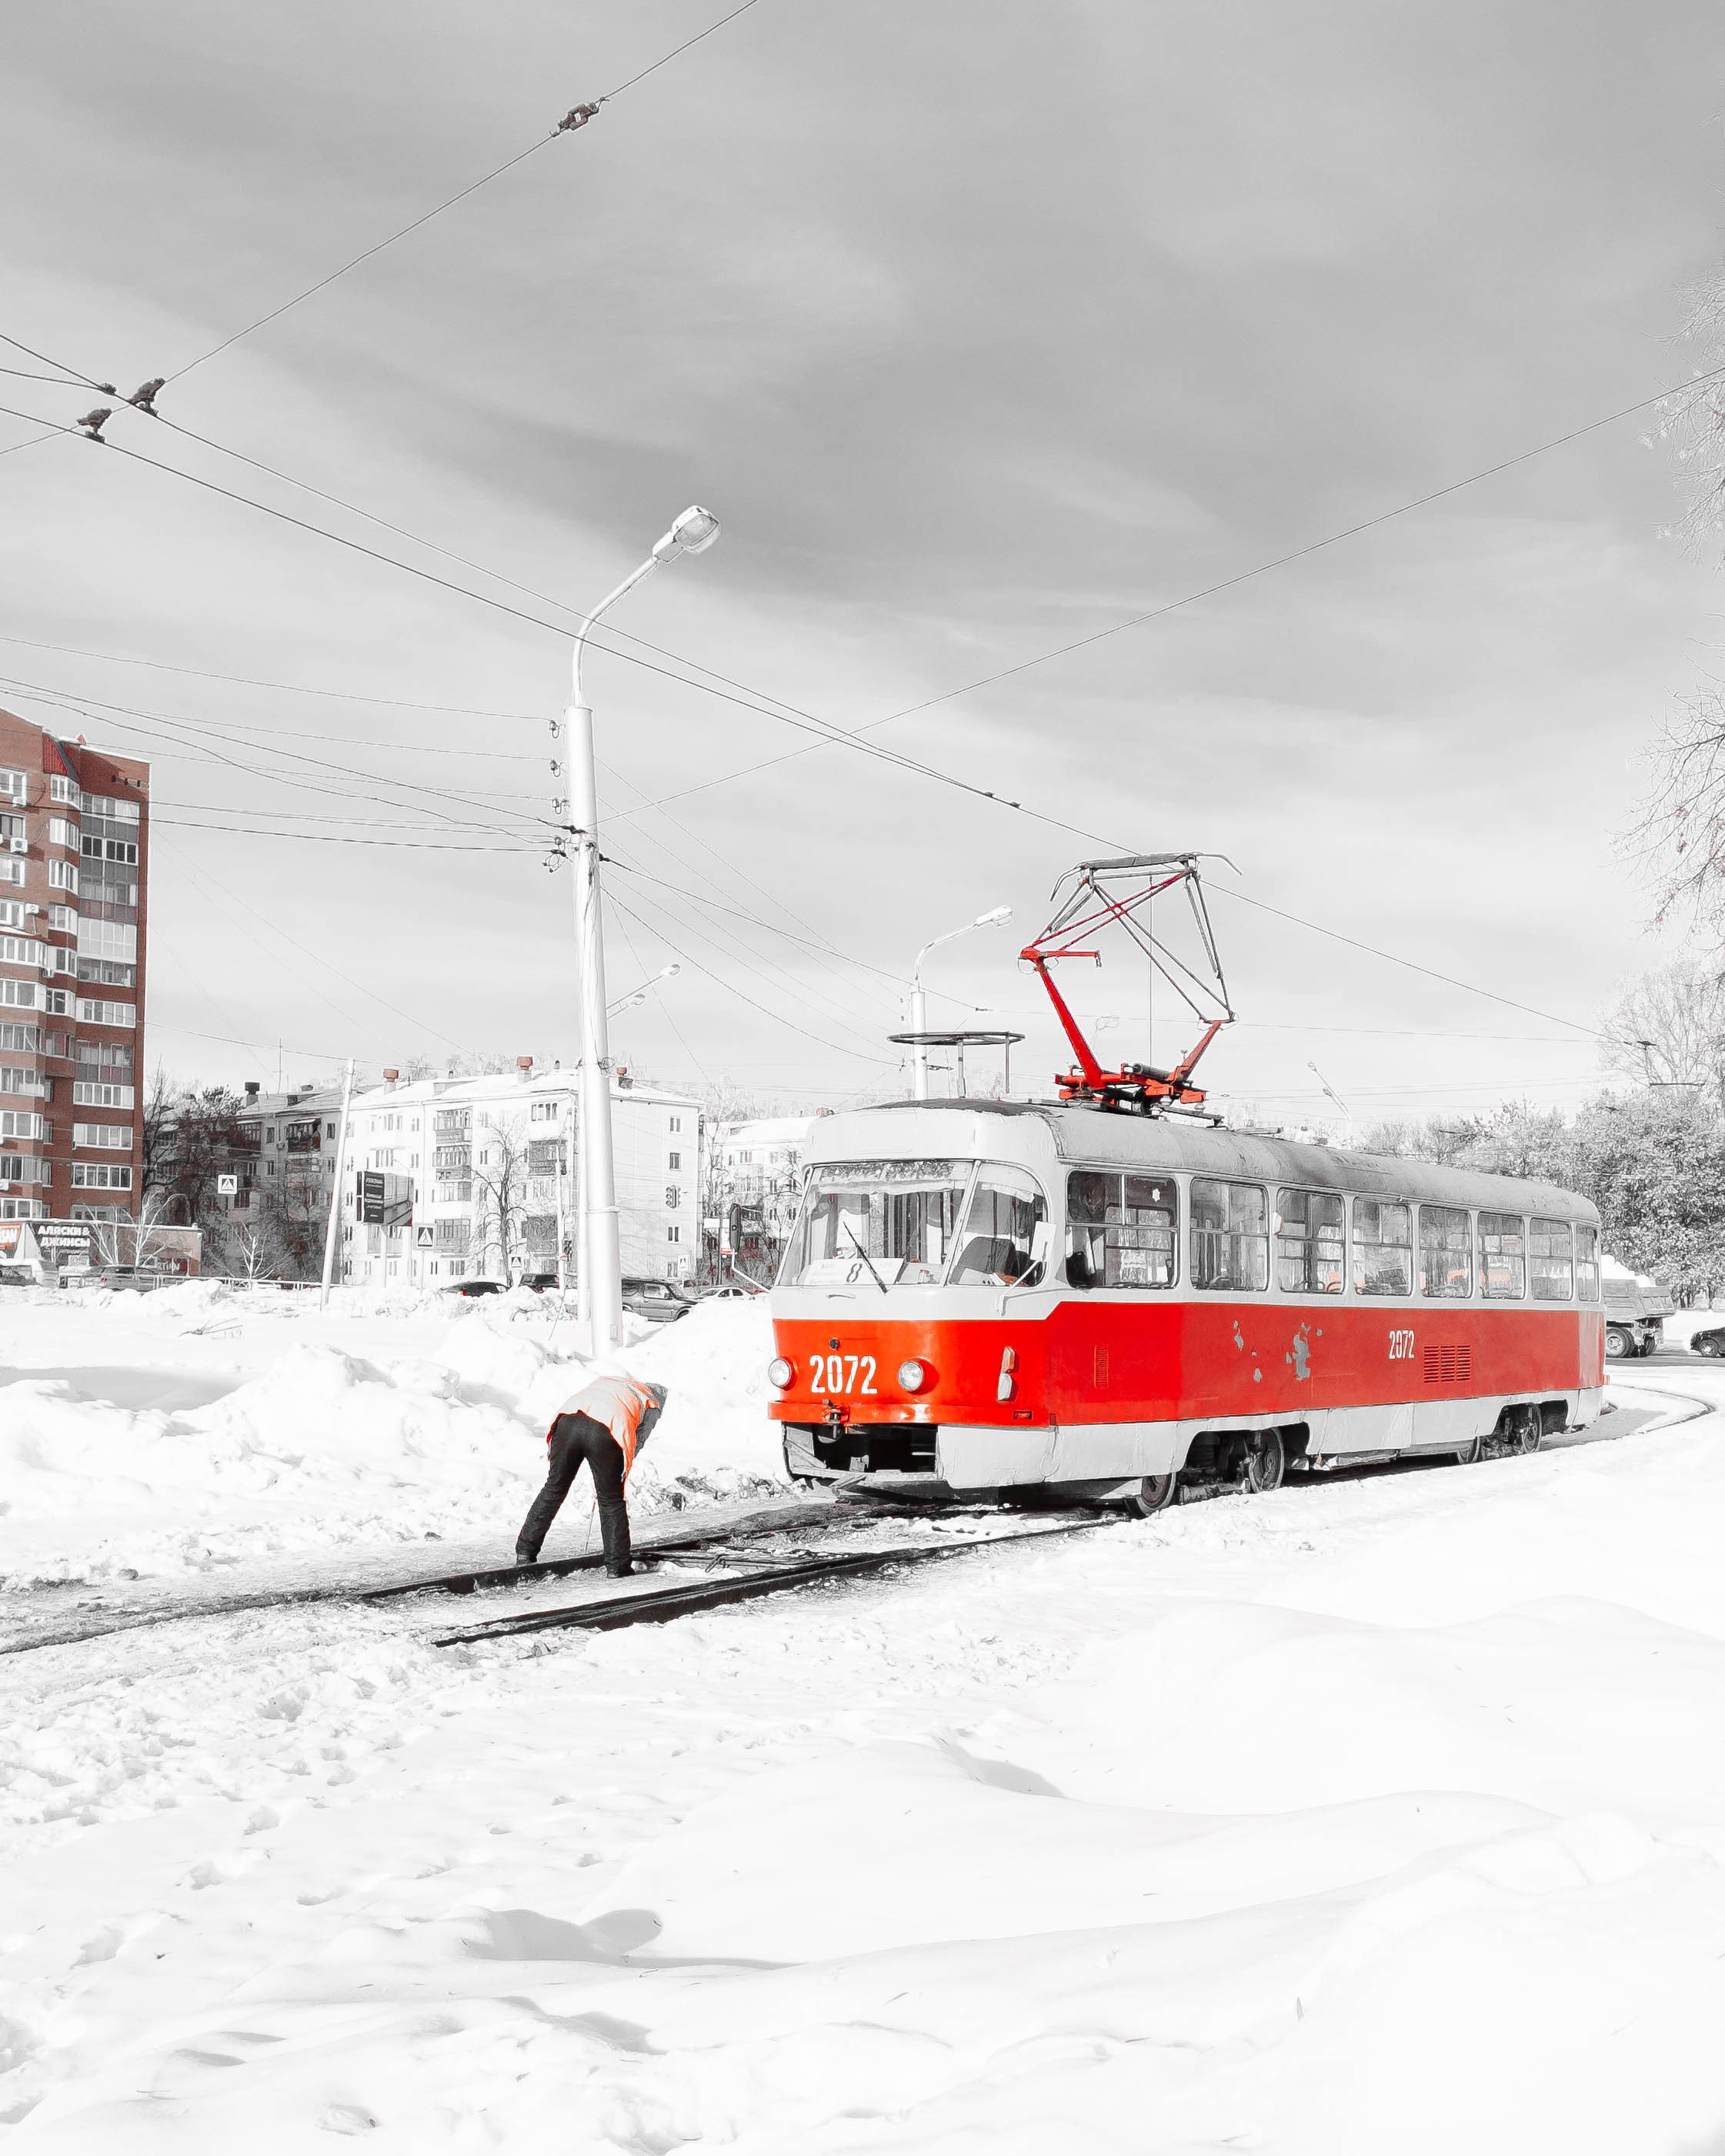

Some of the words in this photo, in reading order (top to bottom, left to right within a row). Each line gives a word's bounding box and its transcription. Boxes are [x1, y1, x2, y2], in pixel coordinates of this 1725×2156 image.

[40, 1237, 91, 1247] ДЖИНСЫ
[846, 1263, 862, 1283] 8
[1389, 1330, 1415, 1360] 2072
[809, 1354, 878, 1394] 2072
